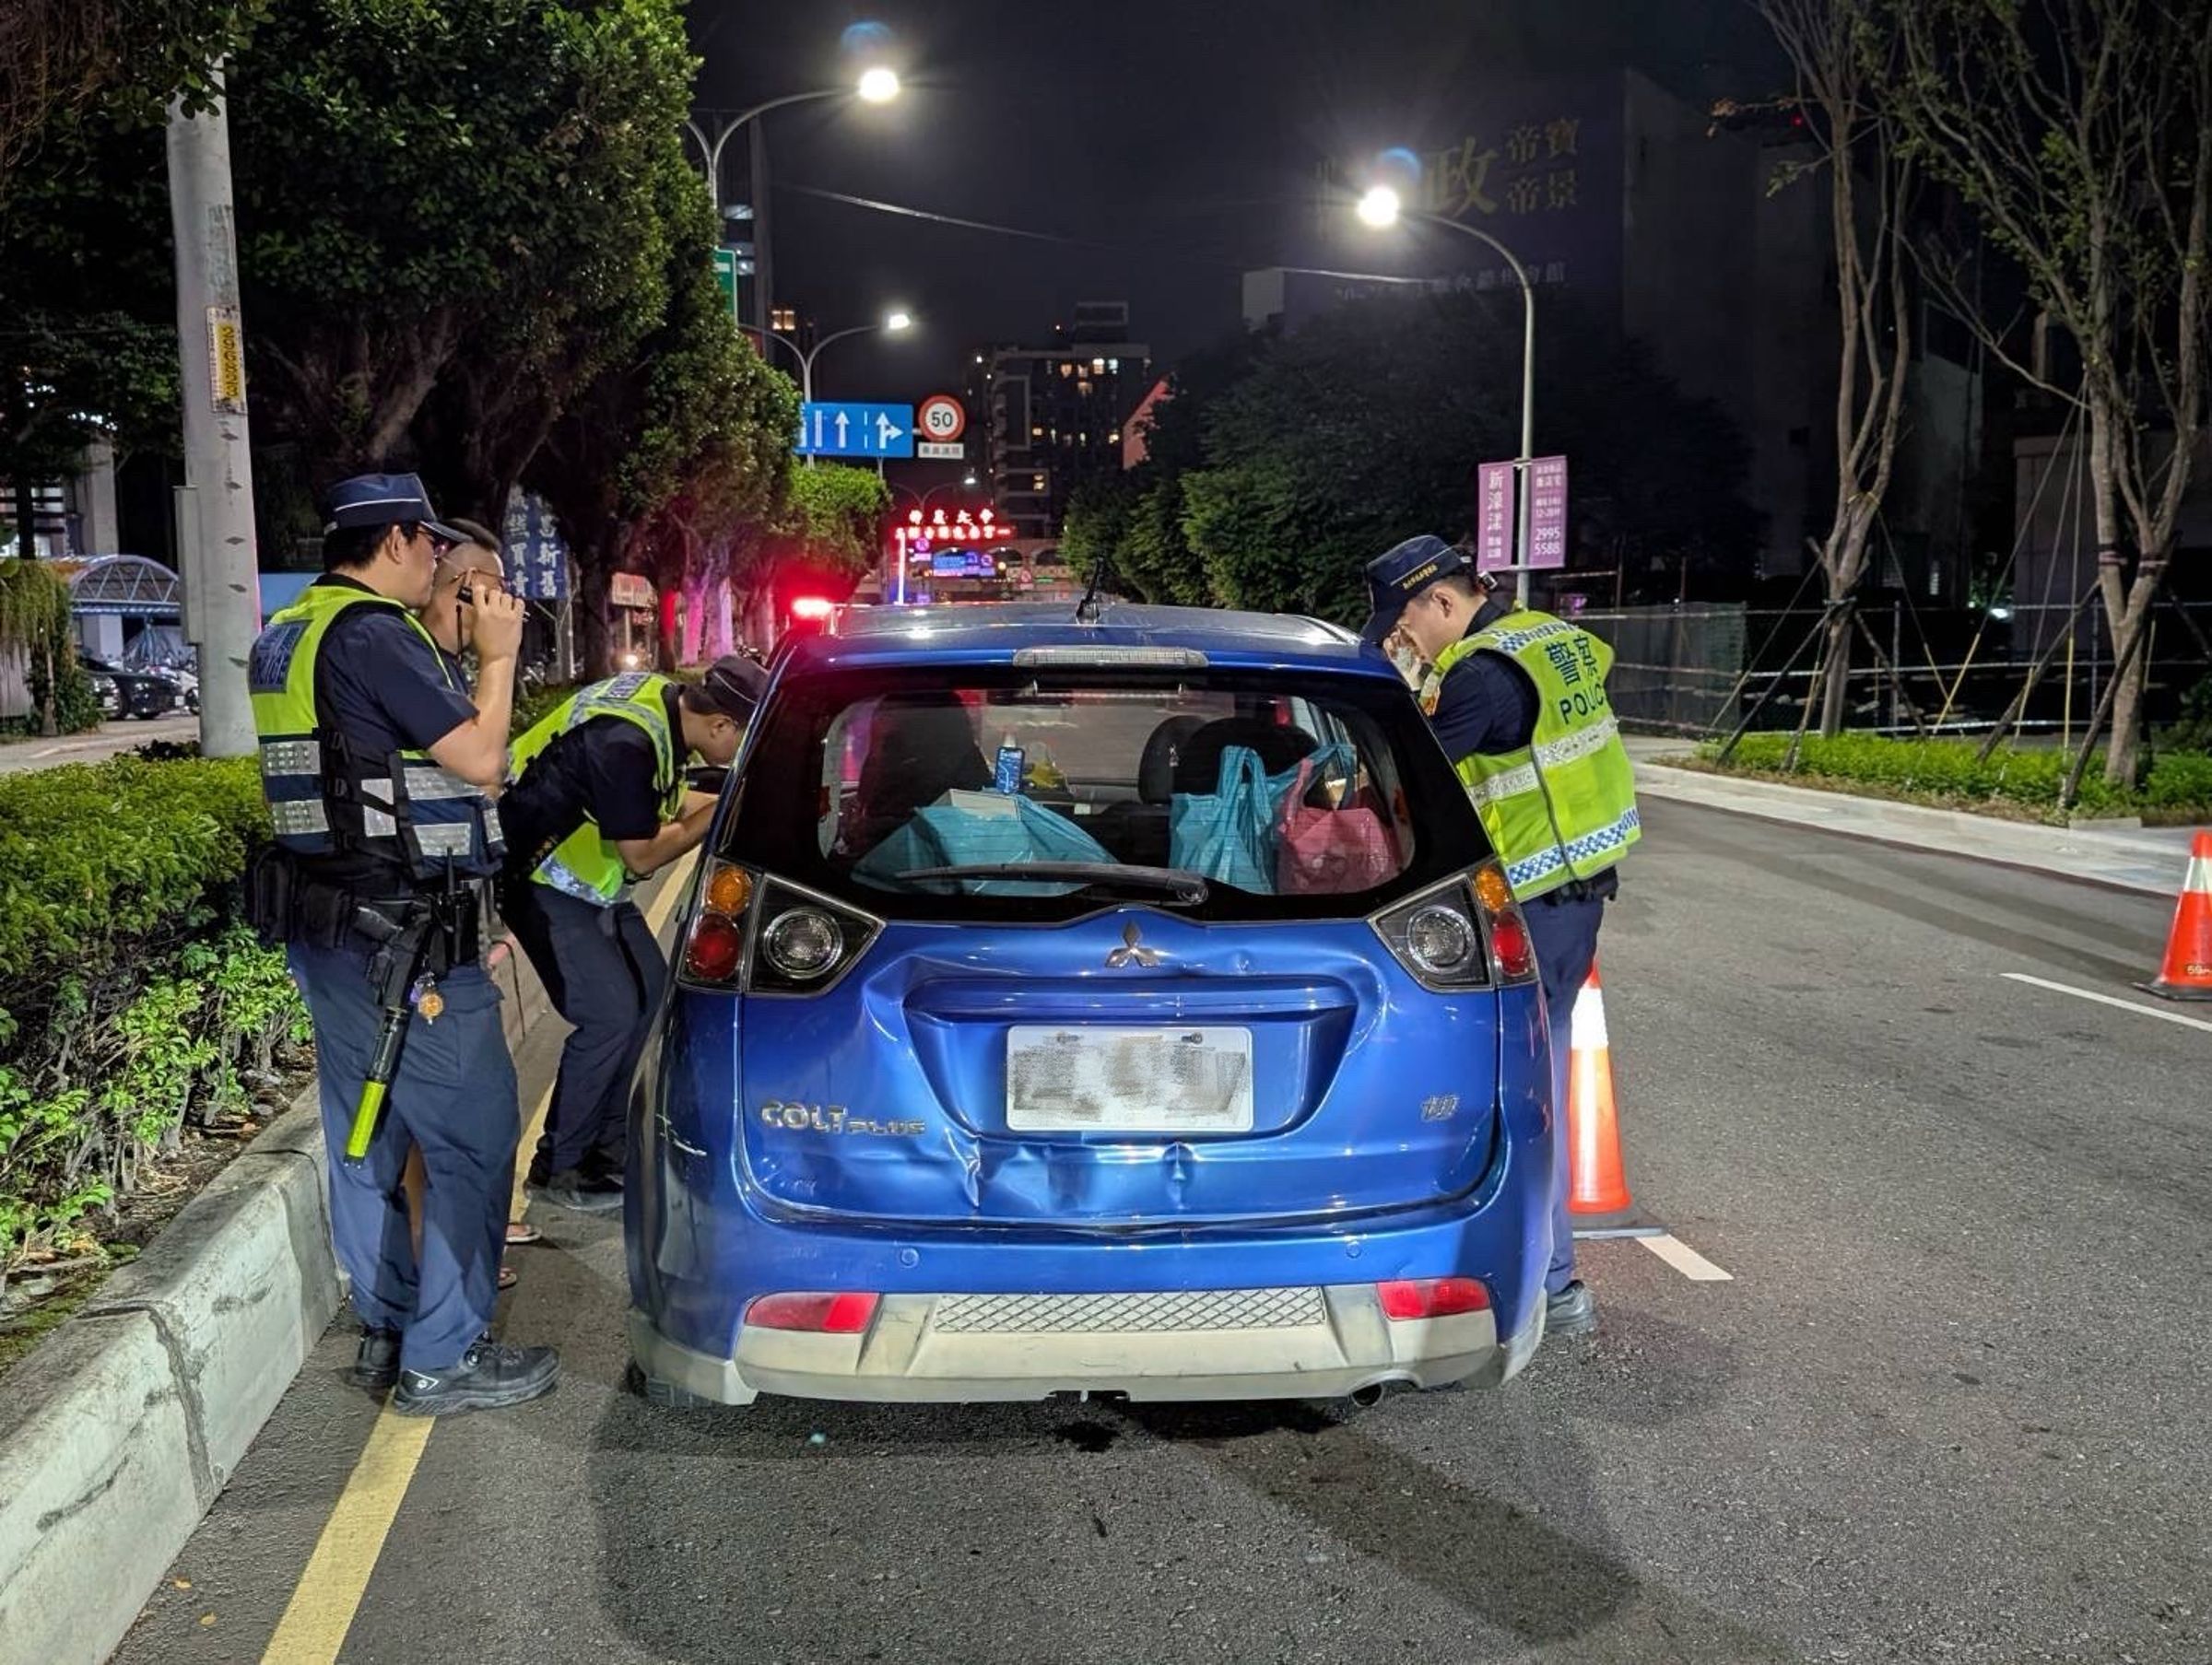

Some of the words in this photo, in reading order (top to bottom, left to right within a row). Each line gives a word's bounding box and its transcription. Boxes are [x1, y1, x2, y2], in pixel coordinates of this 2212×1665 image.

[931, 411, 953, 428] 50
[1535, 526, 1560, 542] 2995
[1545, 634, 1601, 687] 警察
[1559, 683, 1606, 725] POLIC
[761, 1100, 847, 1134] COLT
[846, 1118, 925, 1136] PLUS
